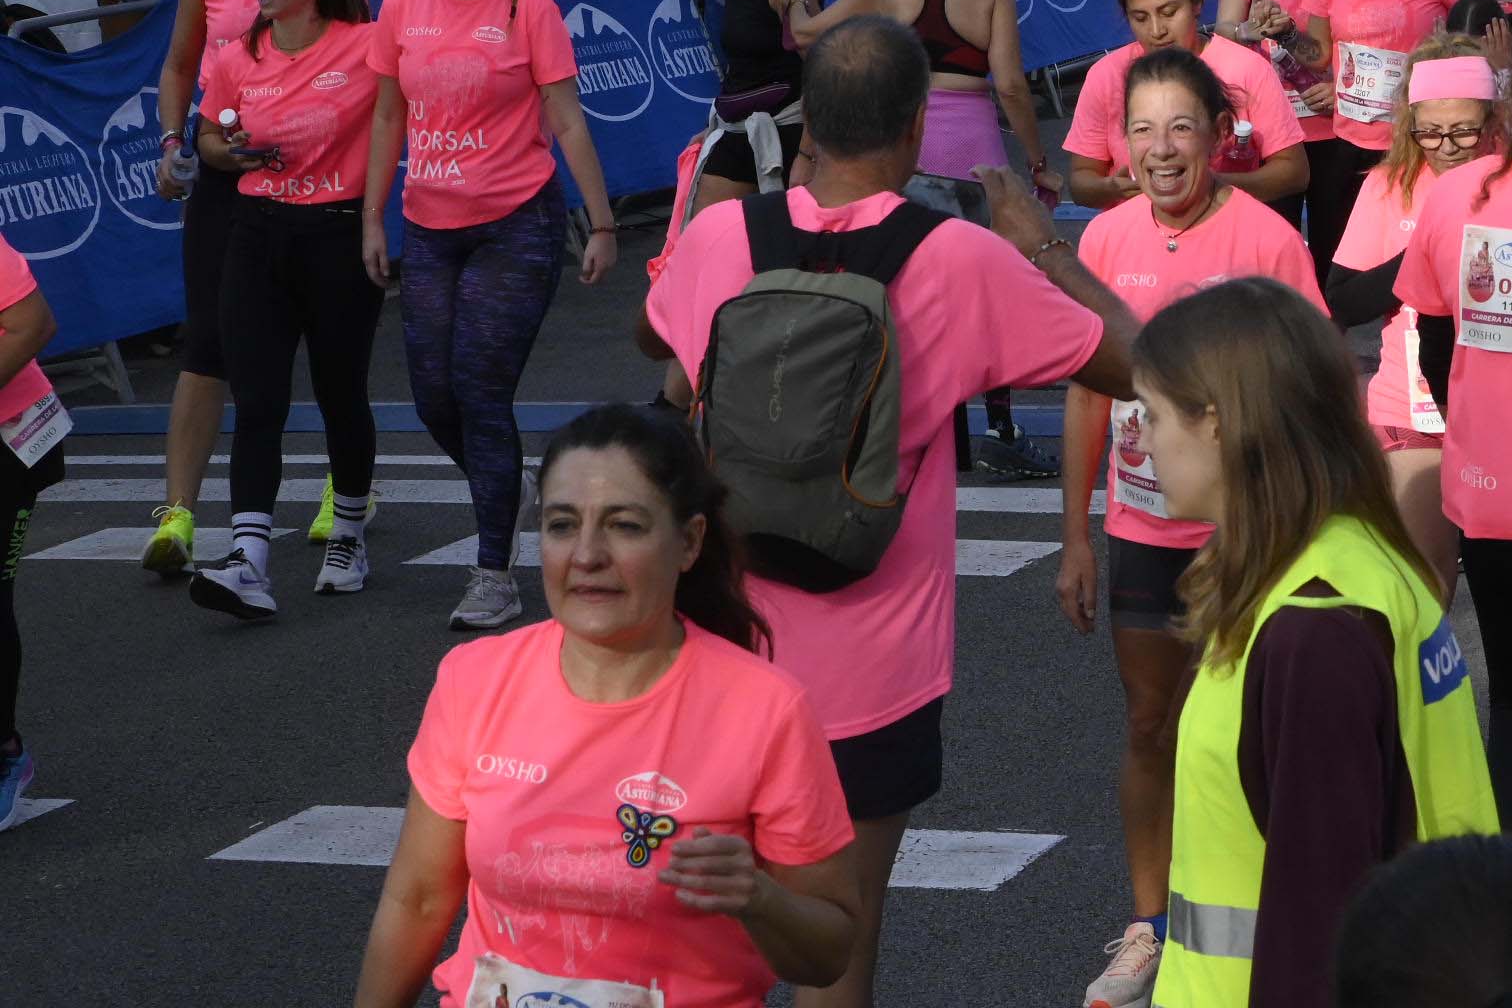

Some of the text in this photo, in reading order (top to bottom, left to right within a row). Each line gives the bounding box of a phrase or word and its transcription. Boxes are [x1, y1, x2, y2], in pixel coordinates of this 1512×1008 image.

[406, 27, 442, 37] OYSHO
[243, 86, 283, 97] OYSHO
[411, 130, 488, 151] DORSAL
[1471, 313, 1502, 323] CARRERA
[1468, 328, 1501, 342] OYSHO
[28, 426, 57, 455] OYSHO
[1126, 474, 1154, 489] CARRERA
[1125, 488, 1154, 505] OYSHO
[476, 754, 548, 785] OYSHO
